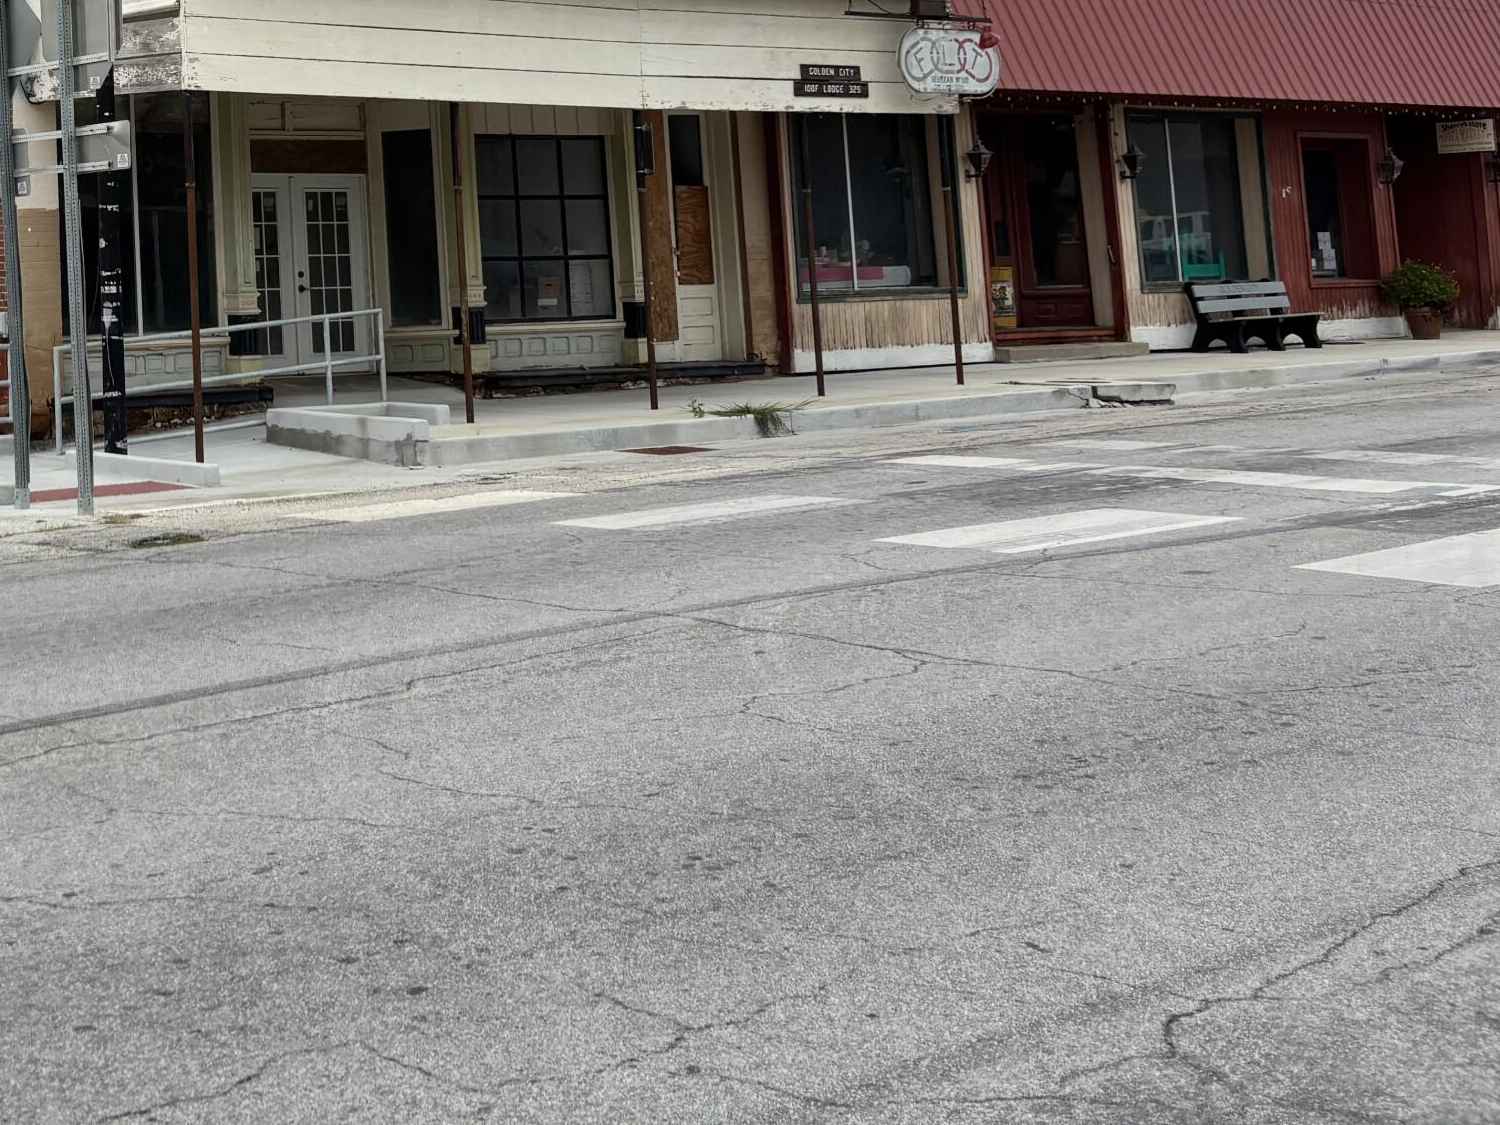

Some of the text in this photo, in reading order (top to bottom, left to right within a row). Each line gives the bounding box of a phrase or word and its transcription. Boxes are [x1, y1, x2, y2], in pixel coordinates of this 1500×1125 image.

[809, 67, 855, 77] GOLDEN CITY
[804, 84, 861, 94] IOOF LODGE 325
